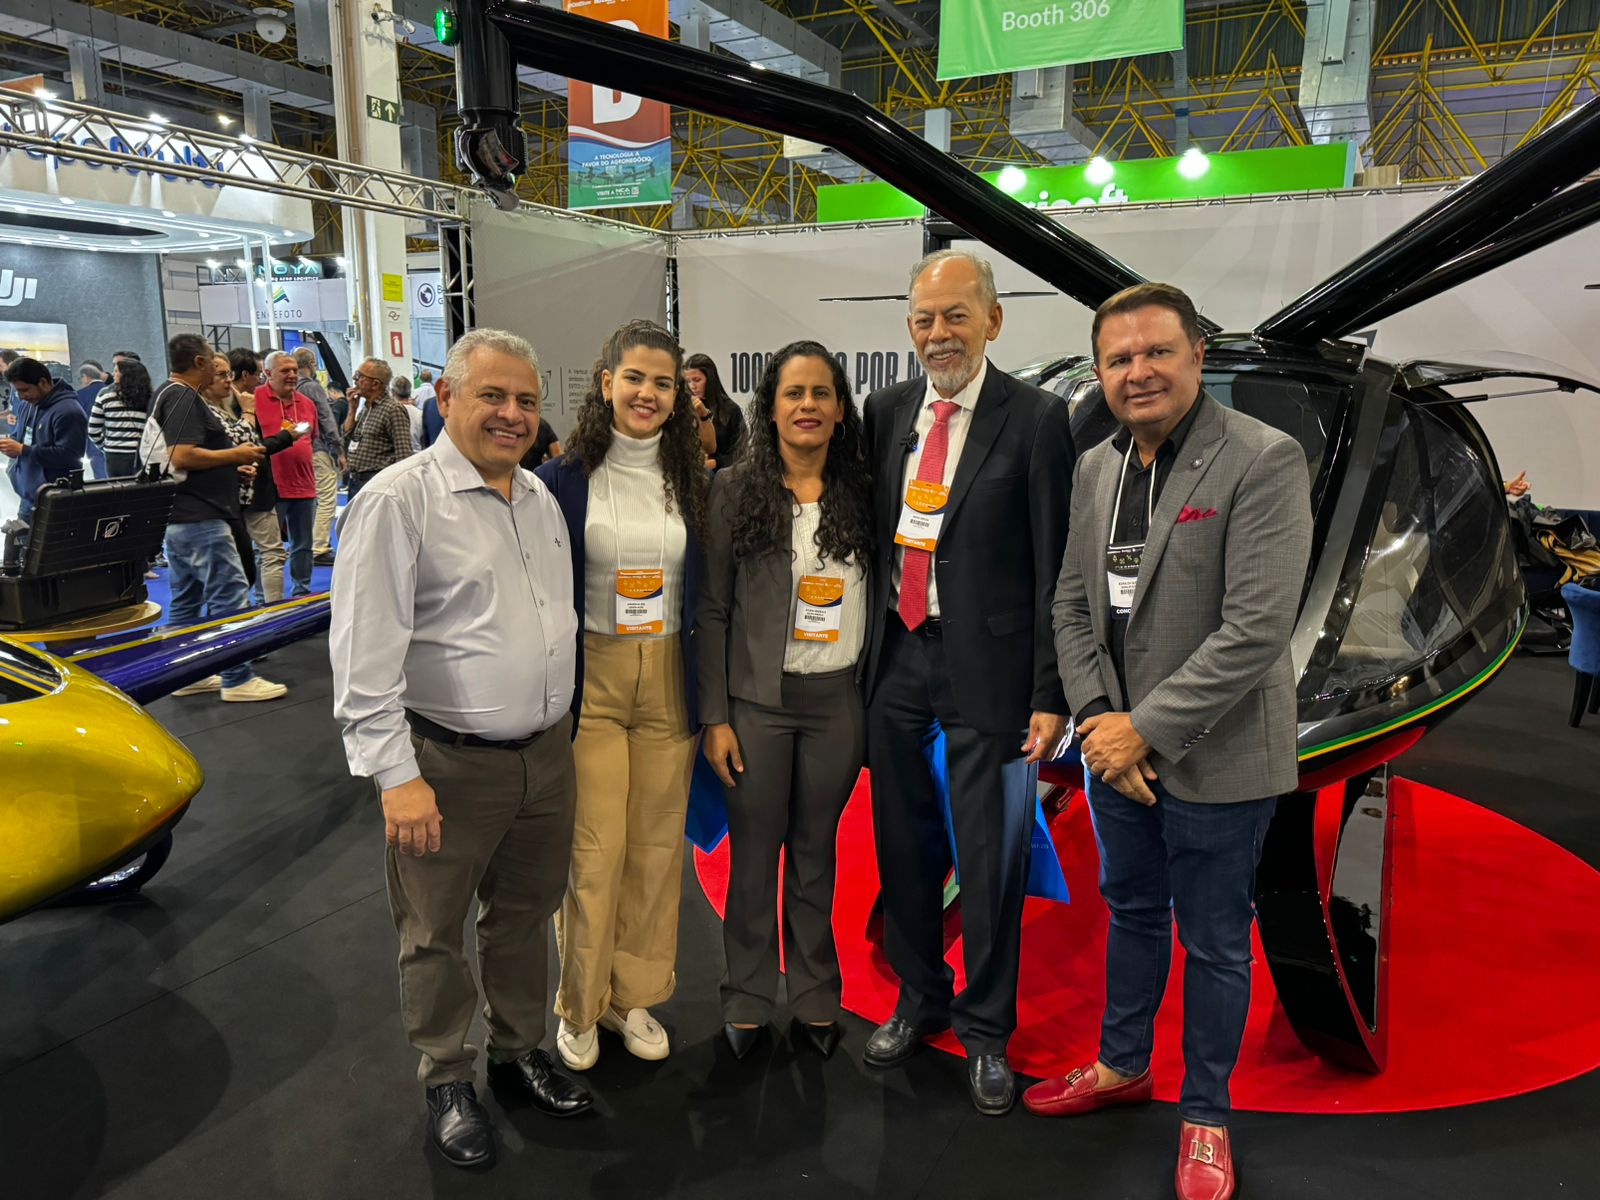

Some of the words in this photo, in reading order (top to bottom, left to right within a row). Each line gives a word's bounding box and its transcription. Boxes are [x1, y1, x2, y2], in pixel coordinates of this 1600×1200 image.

[1001, 4, 1064, 32] Booth
[1069, 0, 1111, 23] 306
[600, 151, 634, 160] TECNOLOGIA
[256, 309, 303, 320] ENEFOTO
[855, 351, 899, 395] POR
